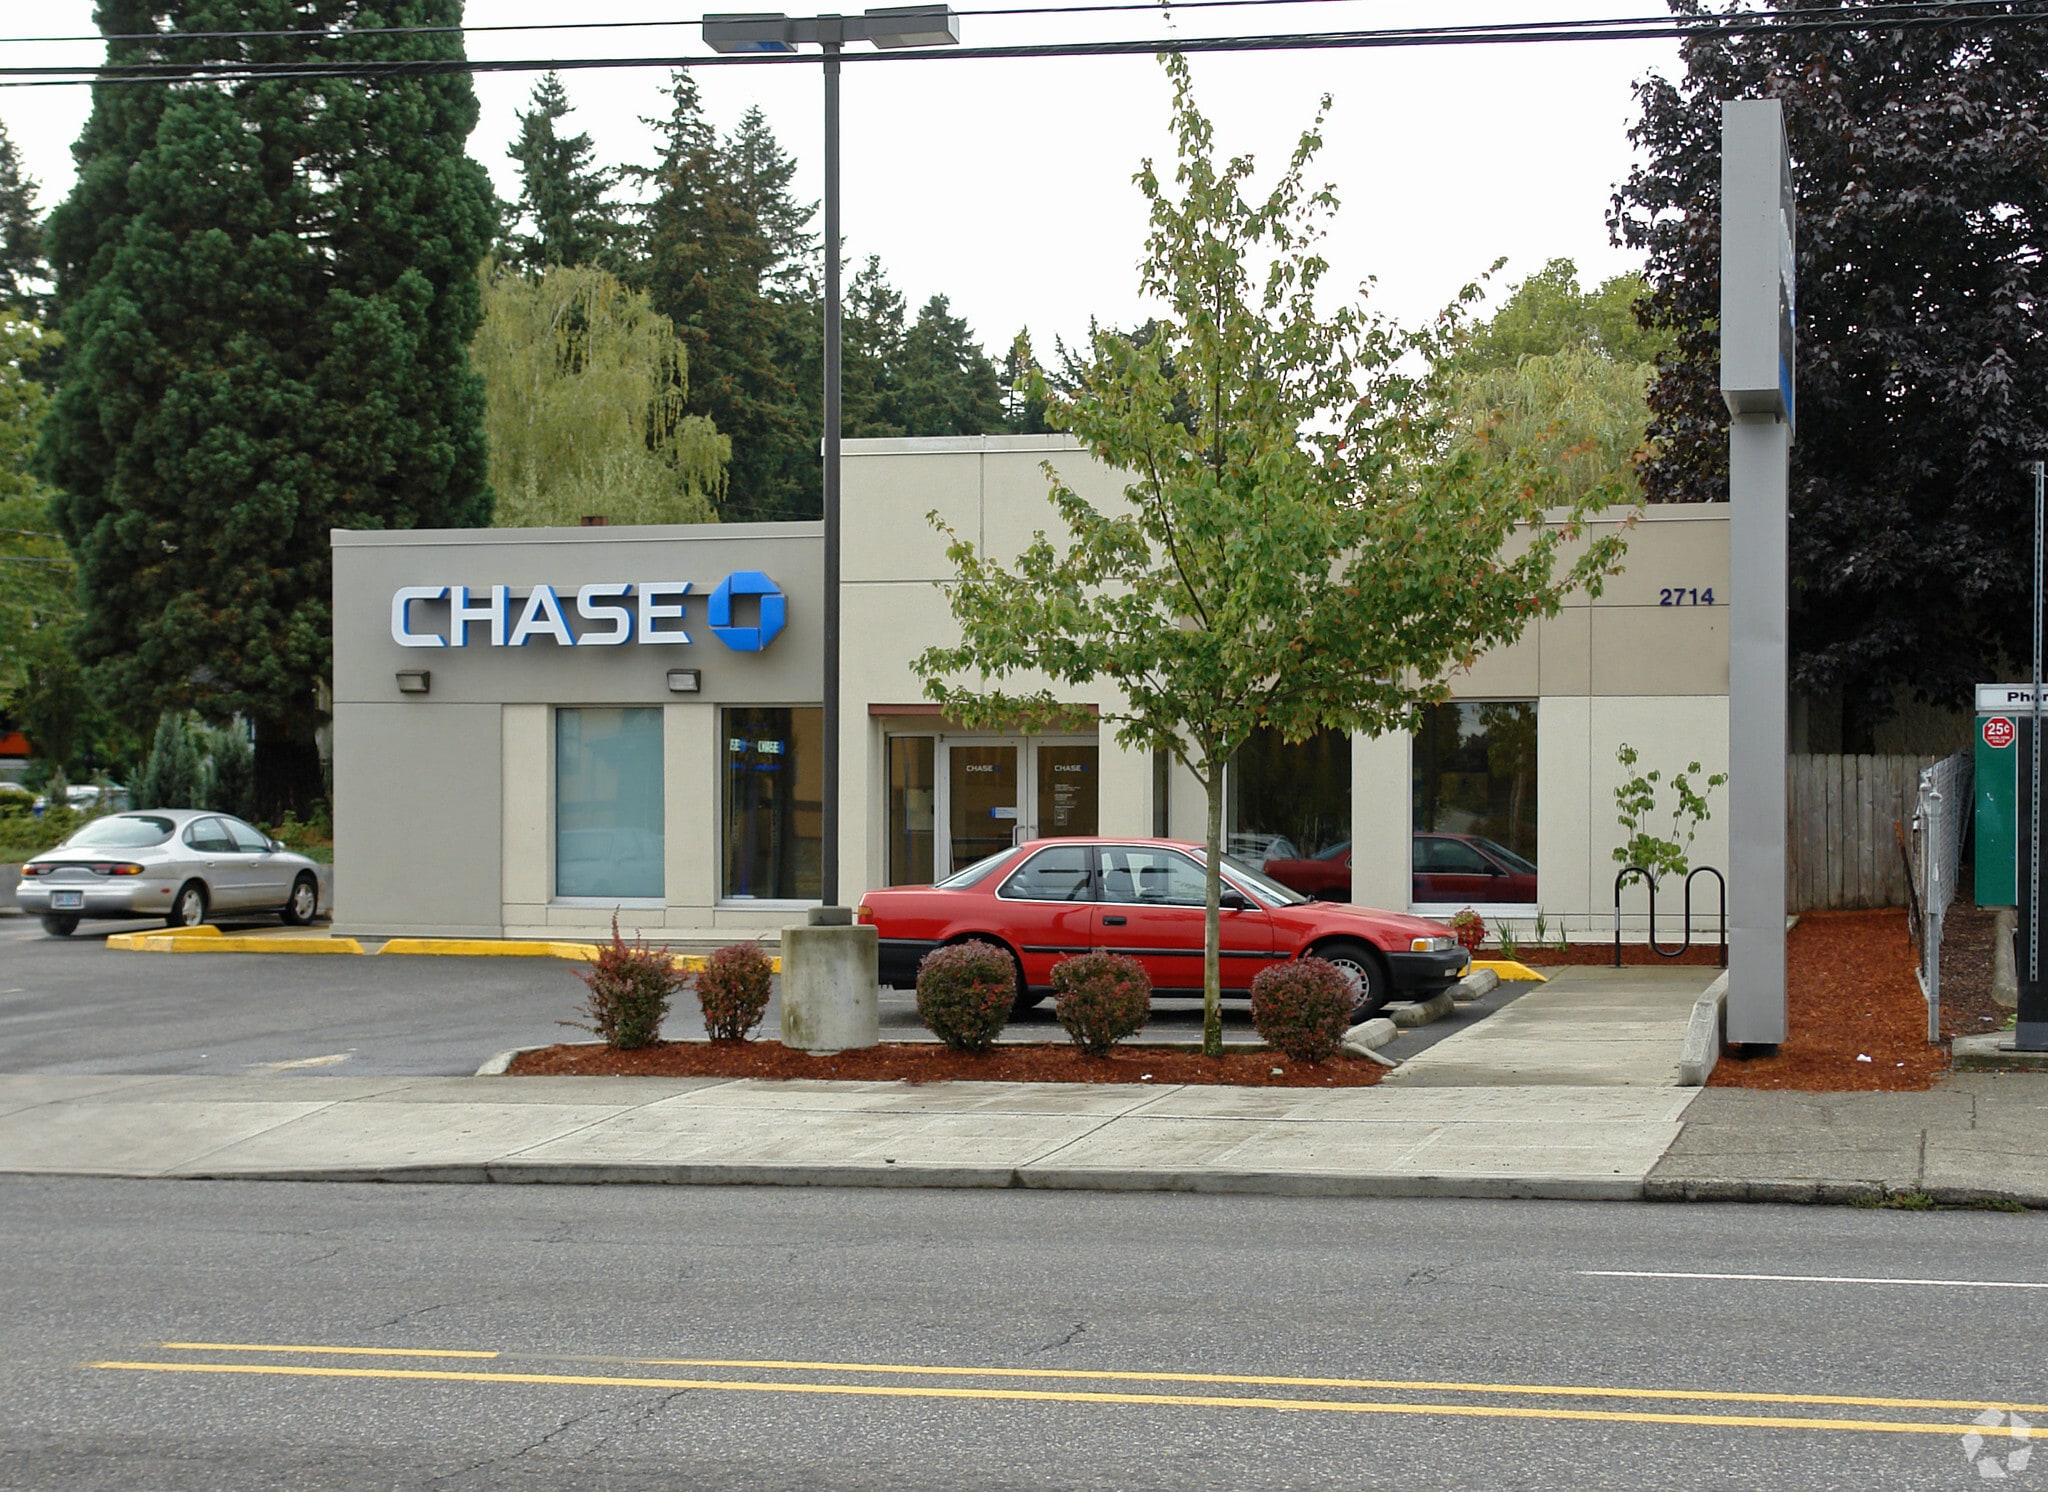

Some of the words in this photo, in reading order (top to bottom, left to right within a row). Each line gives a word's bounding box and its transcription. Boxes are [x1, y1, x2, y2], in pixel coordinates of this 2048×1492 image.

[1659, 588, 1715, 606] 2714
[391, 581, 693, 647] CHASE
[1987, 723, 2011, 735] 25¢
[966, 764, 994, 772] CHASE
[1054, 764, 1082, 772] CHASE
